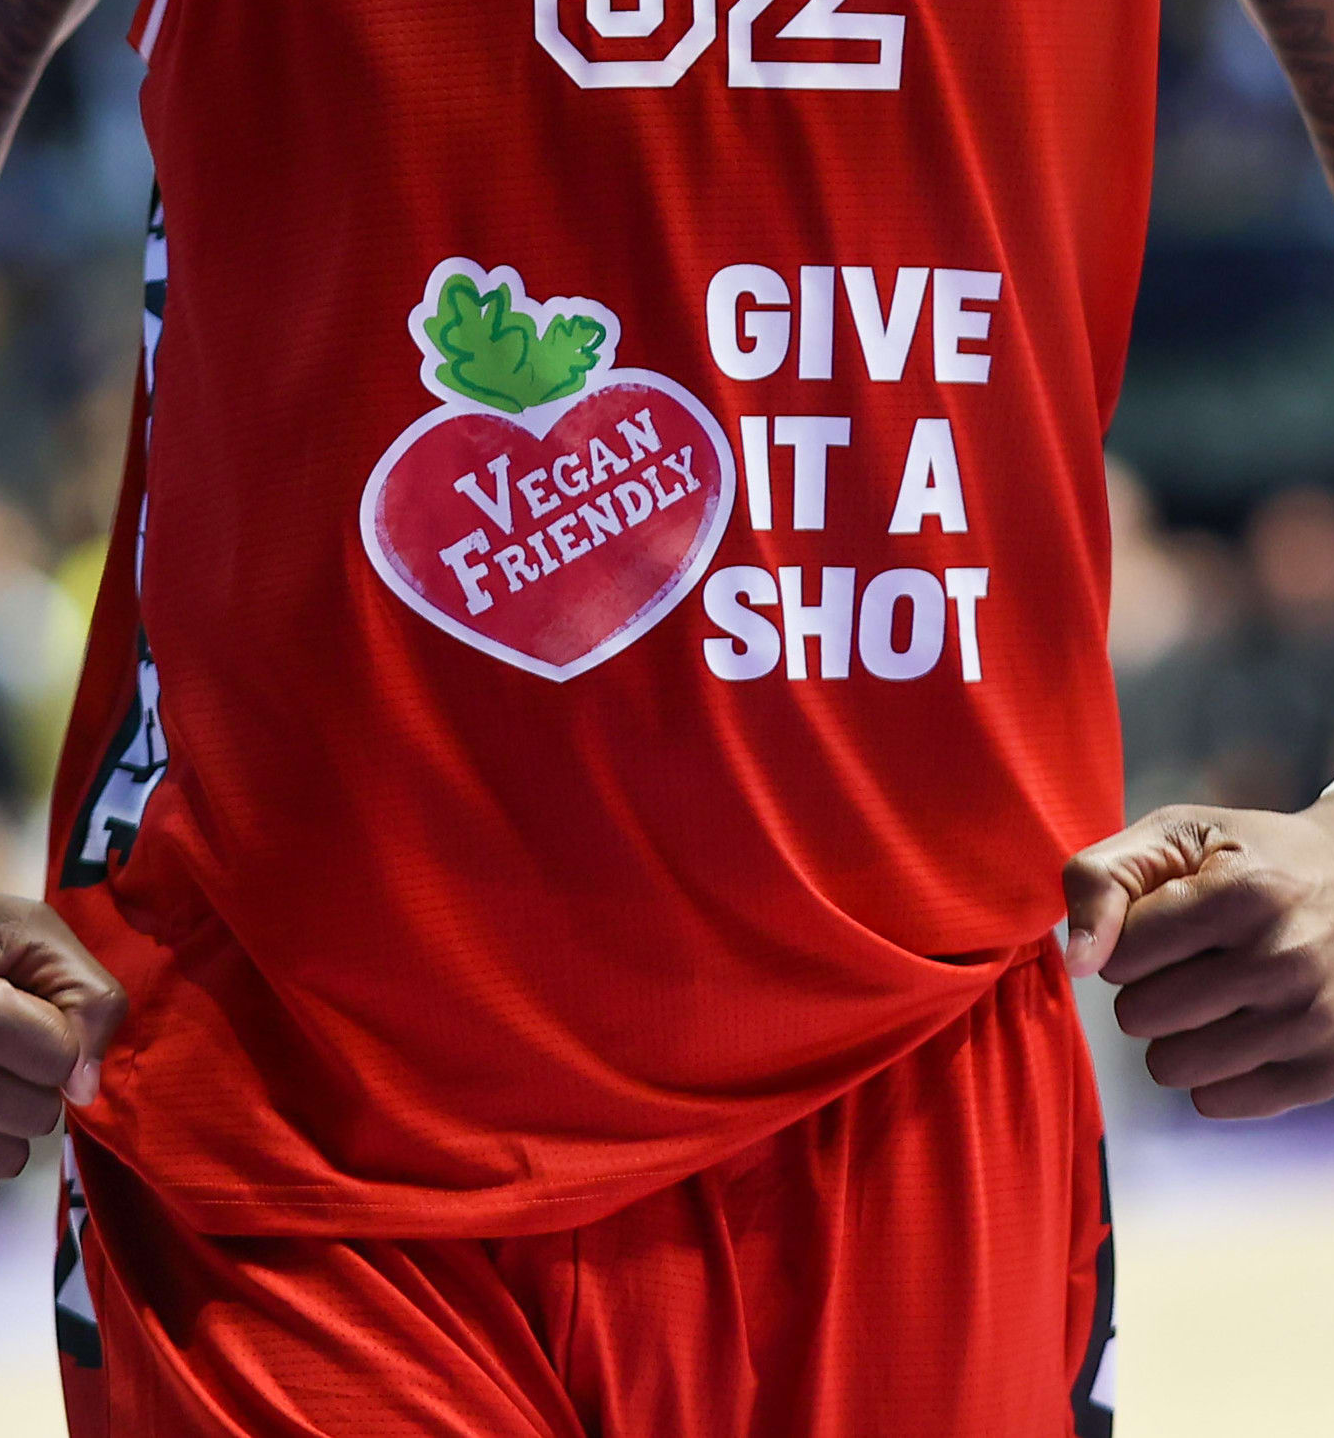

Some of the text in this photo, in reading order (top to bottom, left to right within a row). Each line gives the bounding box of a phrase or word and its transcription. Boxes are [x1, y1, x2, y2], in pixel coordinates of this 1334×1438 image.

[705, 264, 1002, 384] GIVE
[438, 445, 702, 616] FRIENDLY
[453, 407, 664, 536] VEGAN
[740, 415, 968, 534] IT A
[702, 565, 990, 683] SHOT
